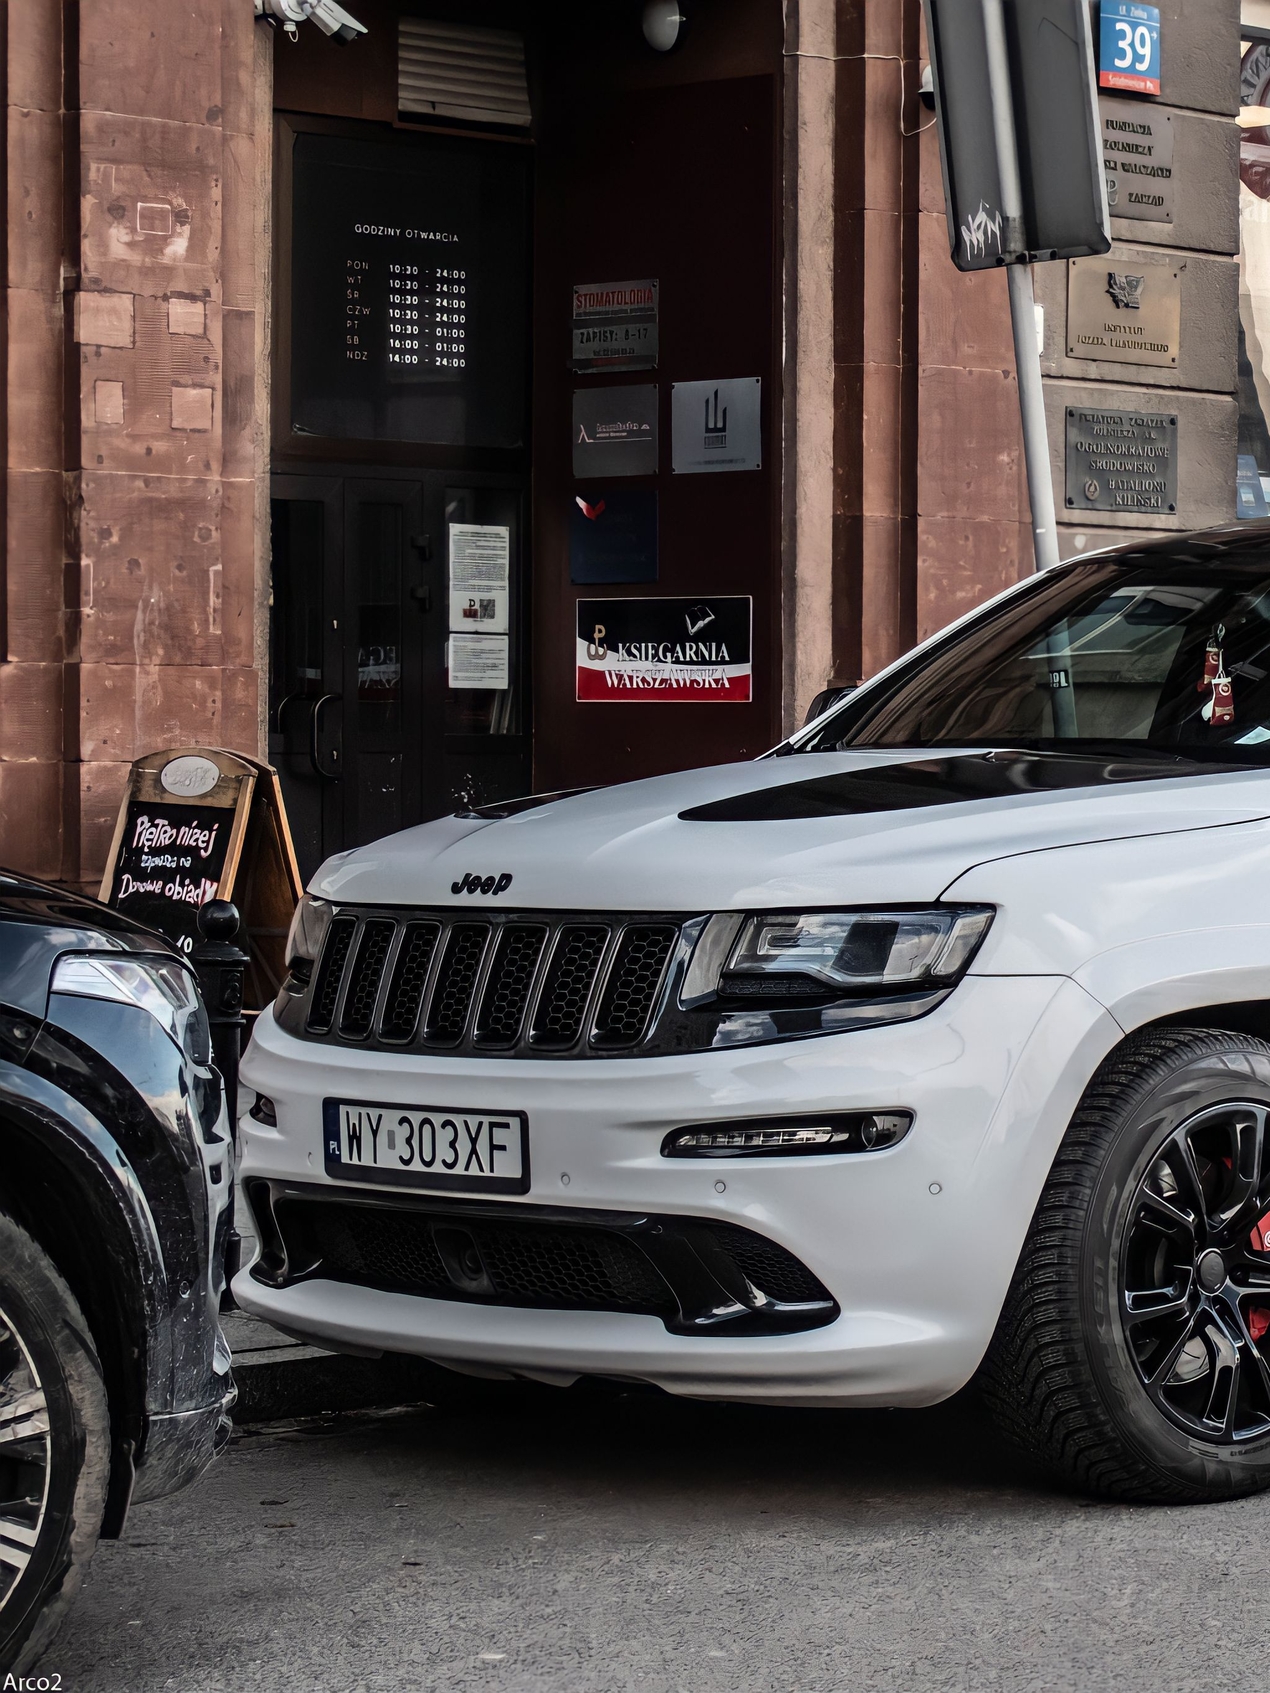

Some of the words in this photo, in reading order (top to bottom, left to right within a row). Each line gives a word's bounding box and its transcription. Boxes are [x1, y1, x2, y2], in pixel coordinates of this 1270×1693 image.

[1114, 21, 1152, 72] 39
[354, 223, 401, 237] GODZINY
[405, 229, 459, 242] OTWARCIA
[346, 260, 369, 270] PON
[389, 264, 419, 276] 10:30
[436, 268, 466, 280] 24:00
[346, 275, 362, 285] WT
[389, 279, 419, 290] 10:30
[436, 283, 466, 294] 24:00
[389, 294, 419, 305] 10:30
[436, 298, 466, 309] 24:00
[346, 305, 371, 315] CZW
[389, 309, 419, 320] 10:30
[436, 313, 466, 324] 24:00
[346, 320, 359, 329] PT
[389, 323, 419, 335] 10:30
[436, 328, 466, 339] 01:00
[389, 338, 419, 350] 16:00
[436, 343, 466, 354] 01:00
[346, 350, 368, 361] NDZ
[389, 353, 419, 365] 14:00
[436, 358, 466, 369] 24:00
[617, 642, 730, 667] KSIĘGARNIA
[604, 668, 730, 689] WARSZAWSKA
[451, 872, 514, 896] Jeep
[345, 1110, 383, 1165] WY
[398, 1115, 511, 1174] 303XF
